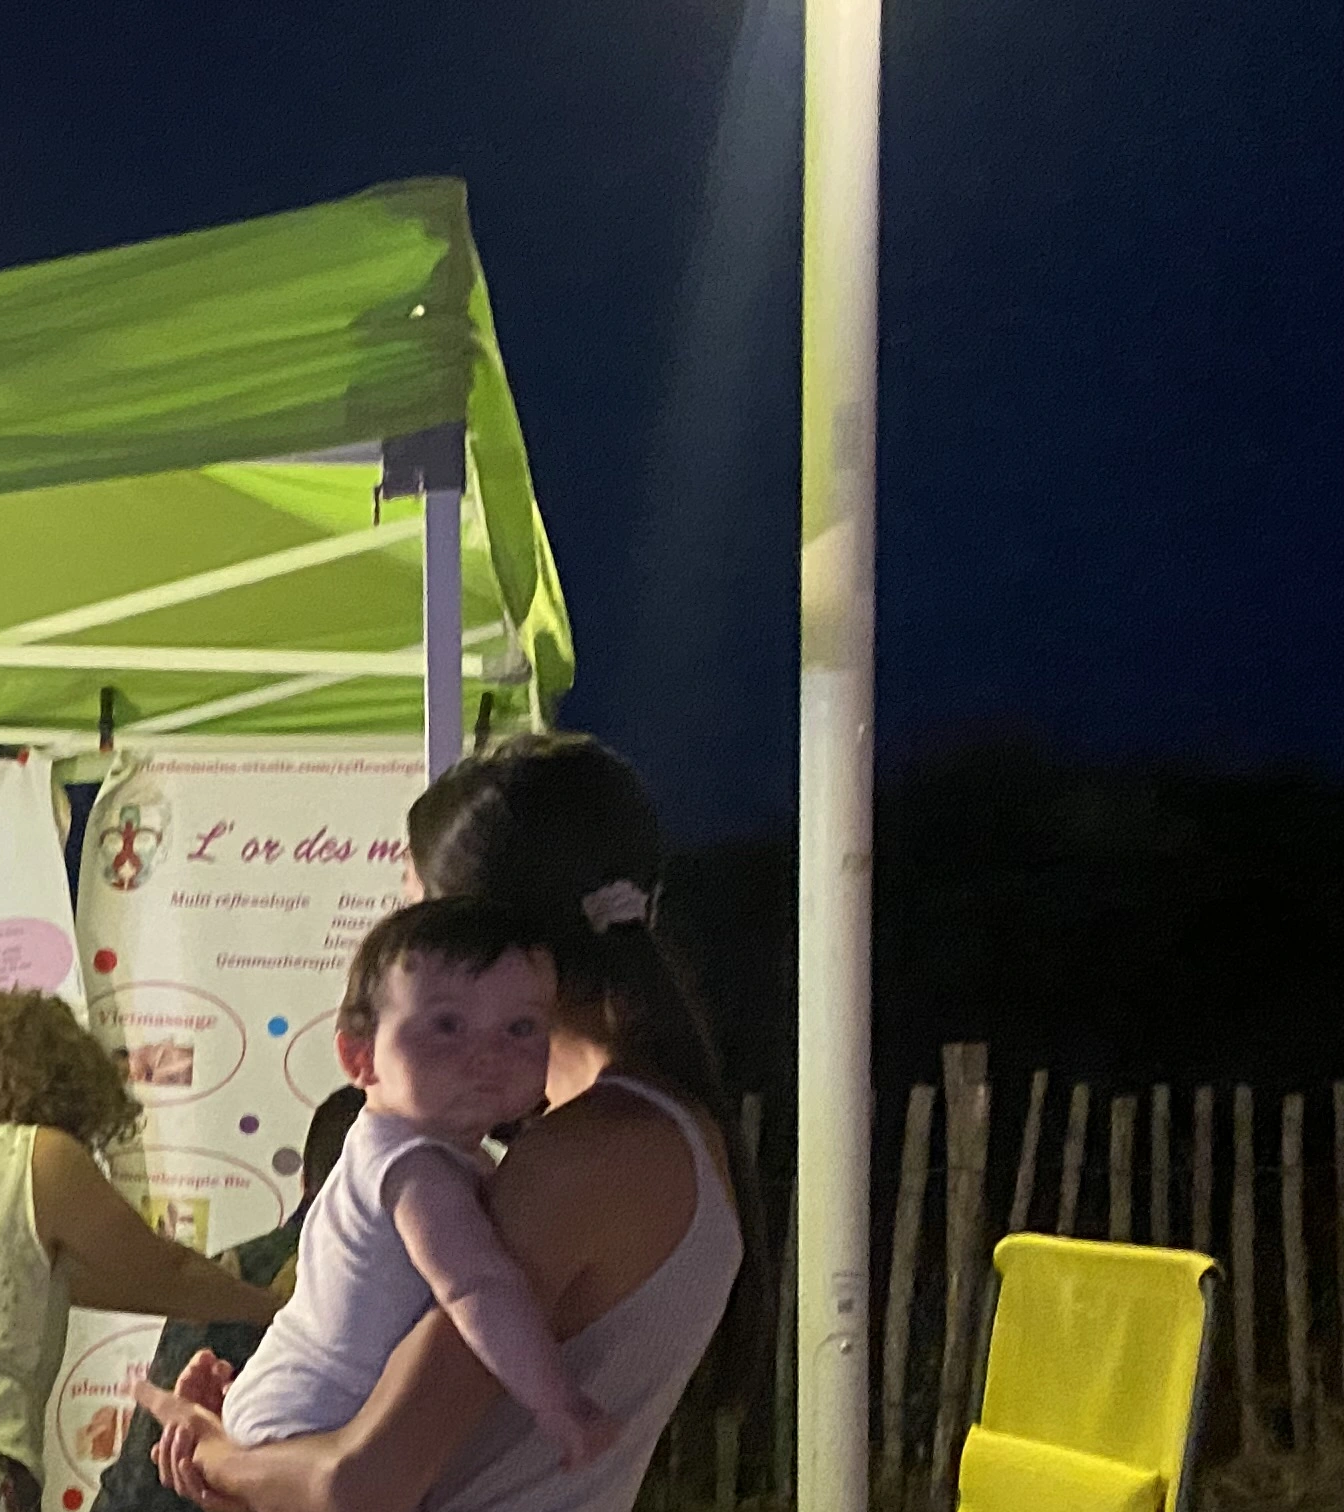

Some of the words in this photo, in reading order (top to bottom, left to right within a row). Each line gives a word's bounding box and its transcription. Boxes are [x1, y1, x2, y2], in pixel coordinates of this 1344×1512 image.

[240, 836, 285, 864] or
[293, 824, 358, 865] des
[171, 890, 212, 909] Multi
